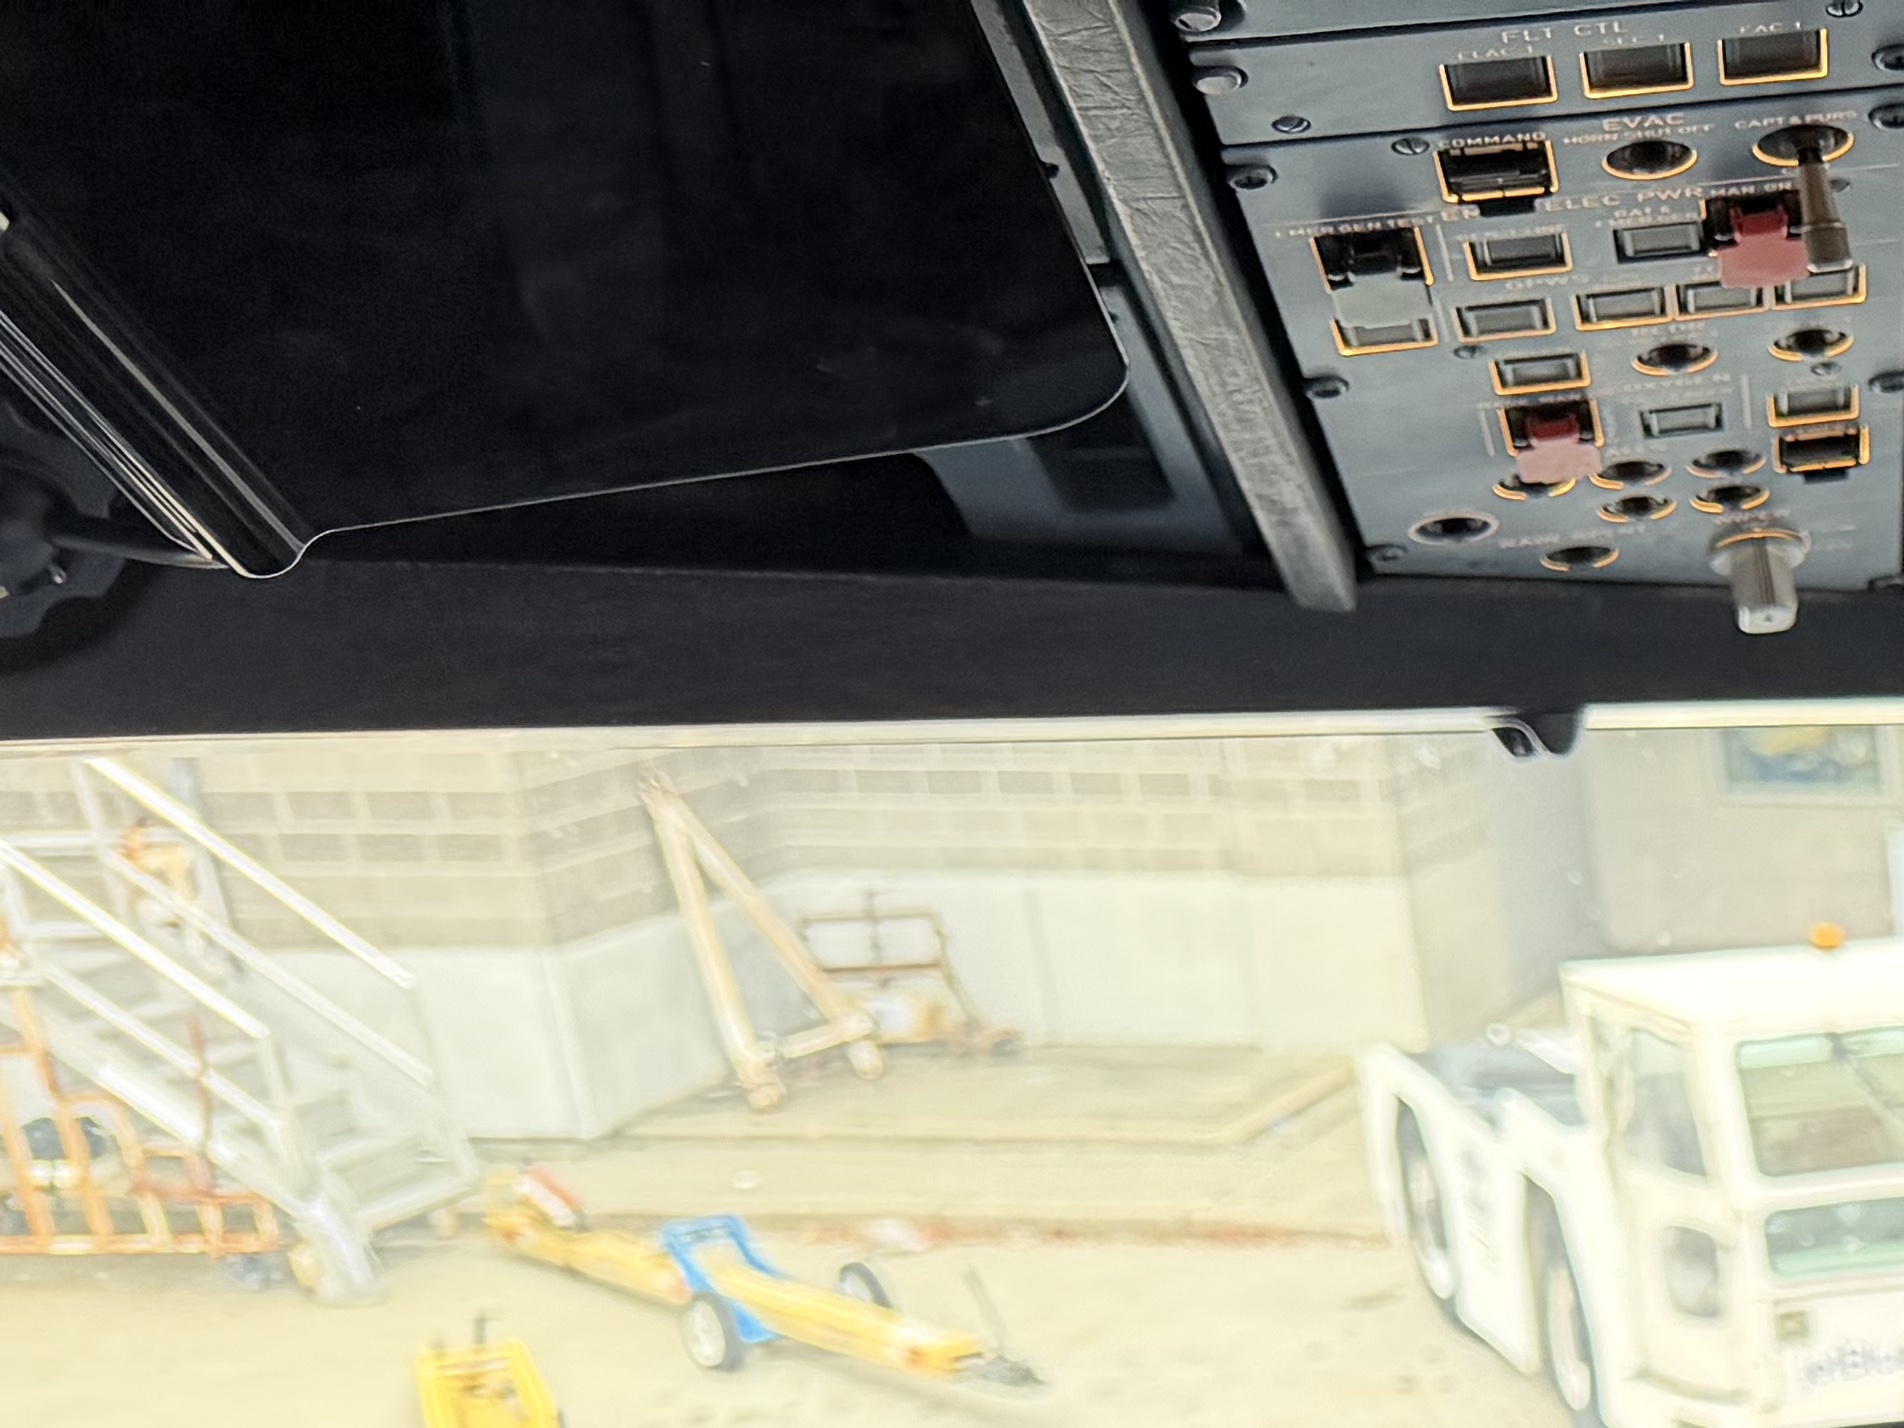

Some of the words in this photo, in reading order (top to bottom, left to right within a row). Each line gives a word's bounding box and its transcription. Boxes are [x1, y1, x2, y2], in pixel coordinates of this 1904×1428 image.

[1501, 27, 1555, 45] FLT
[1574, 20, 1629, 37] CTL
[1602, 113, 1686, 132] EVAC
[1543, 195, 1622, 213] ELEC
[1637, 185, 1703, 203] PWR
